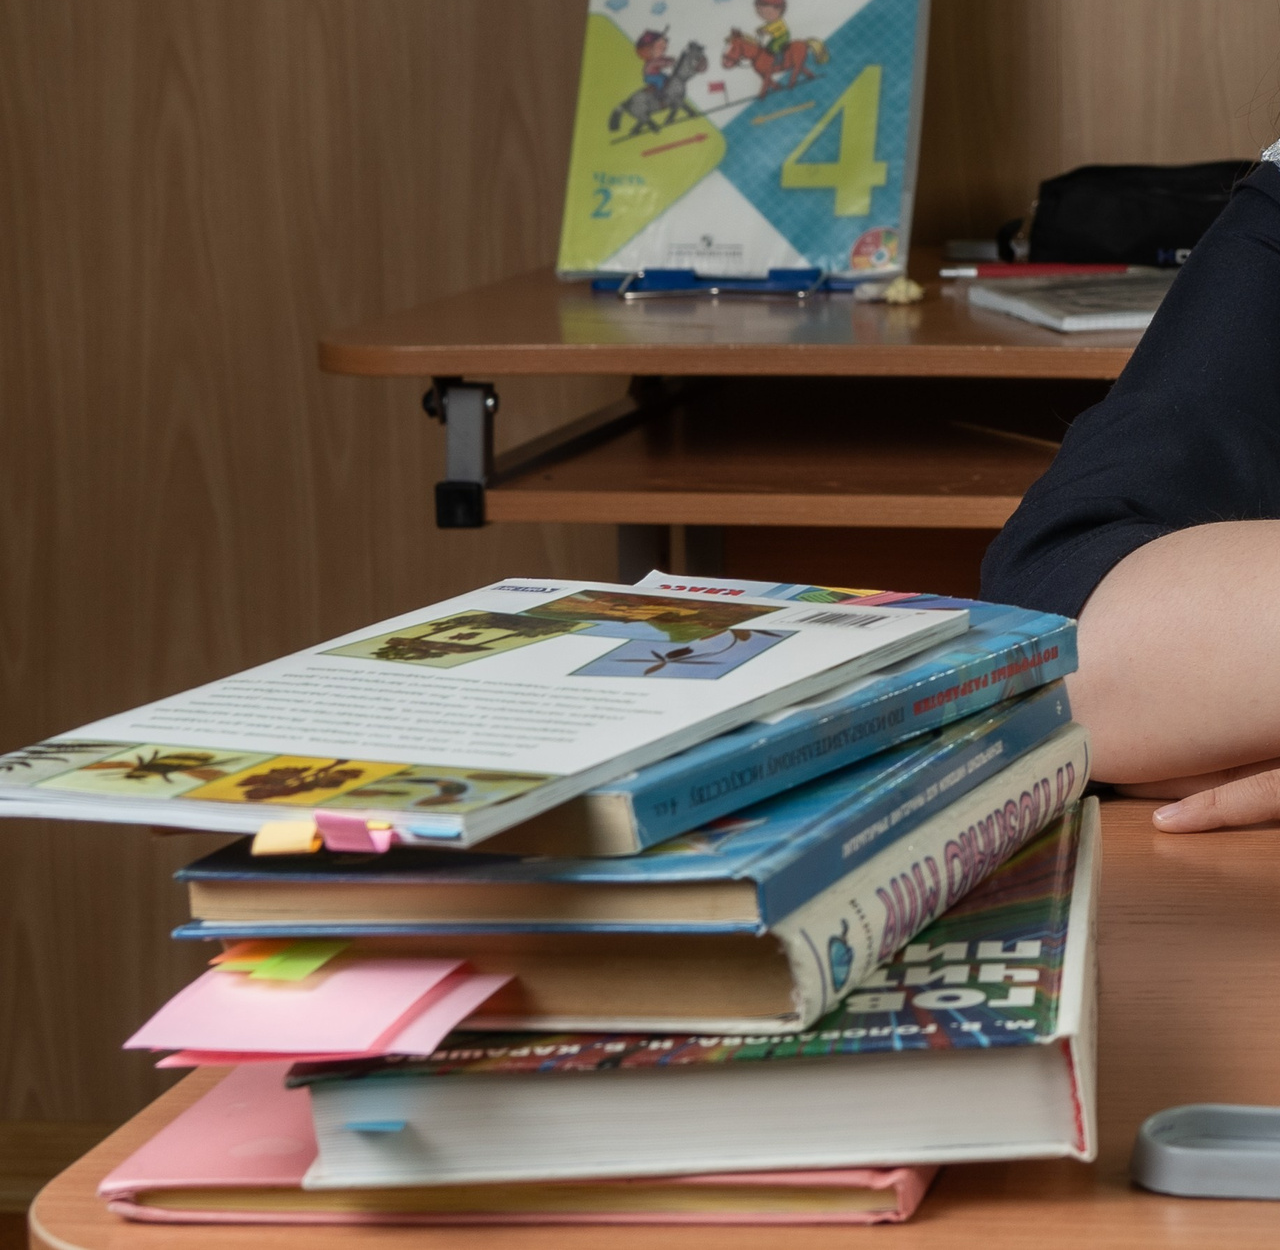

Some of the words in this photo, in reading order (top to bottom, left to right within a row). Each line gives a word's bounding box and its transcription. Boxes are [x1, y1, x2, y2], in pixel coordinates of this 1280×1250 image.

[780, 64, 888, 218] 4
[590, 188, 614, 219] 2
[659, 584, 746, 597] КЛАСС
[903, 940, 1042, 963] ПИ
[858, 963, 1040, 990] ЧИТ
[845, 986, 1037, 1013] ГОВ
